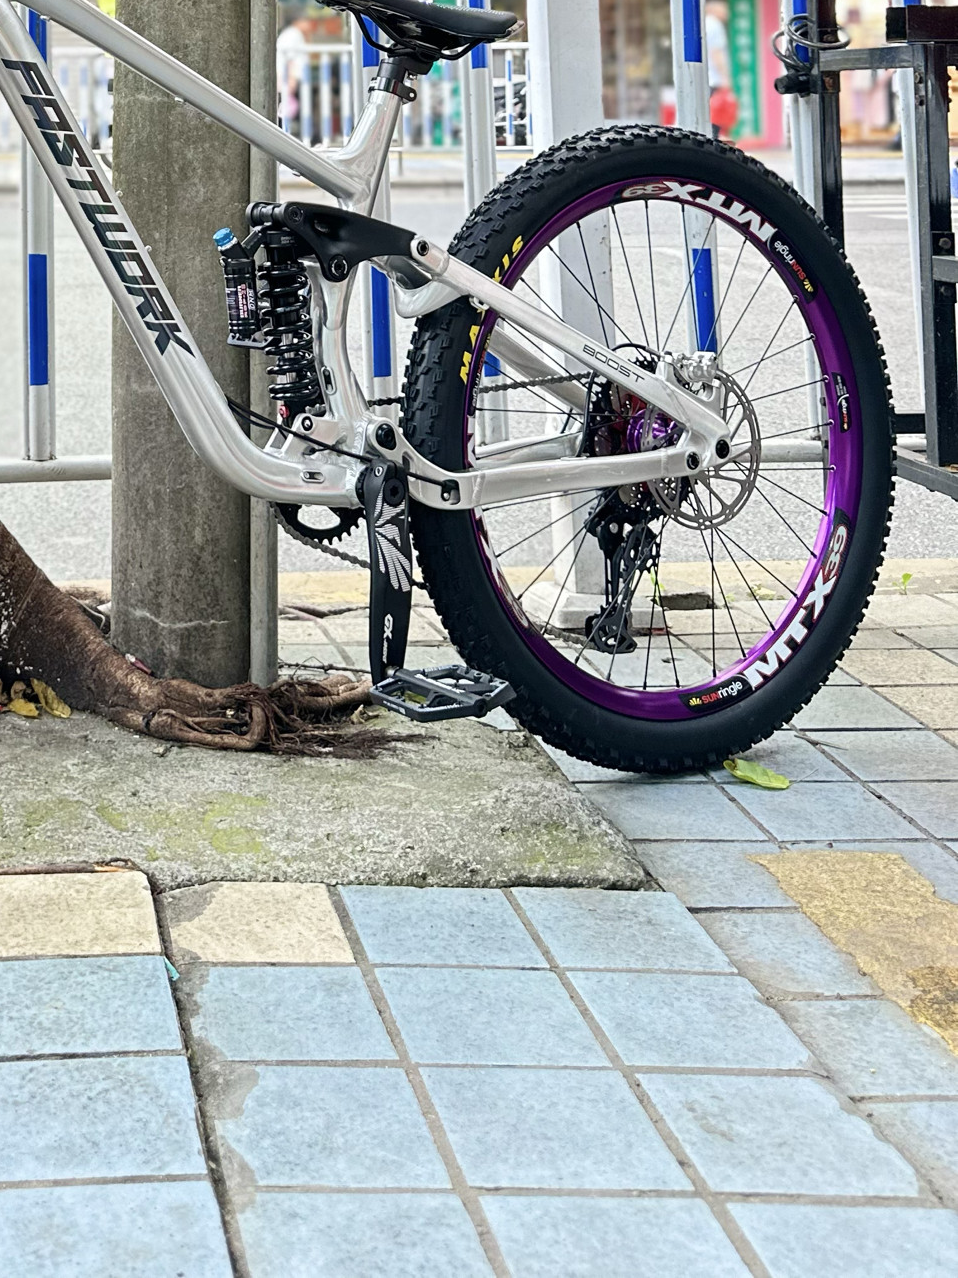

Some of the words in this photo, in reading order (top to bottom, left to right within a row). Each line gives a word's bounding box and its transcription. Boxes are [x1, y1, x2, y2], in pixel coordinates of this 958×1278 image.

[1, 57, 197, 359] FASTWORK
[621, 179, 778, 243] MTX39
[582, 343, 646, 384] BOOST
[742, 524, 848, 692] MTX39
[701, 679, 744, 705] SUNringle
